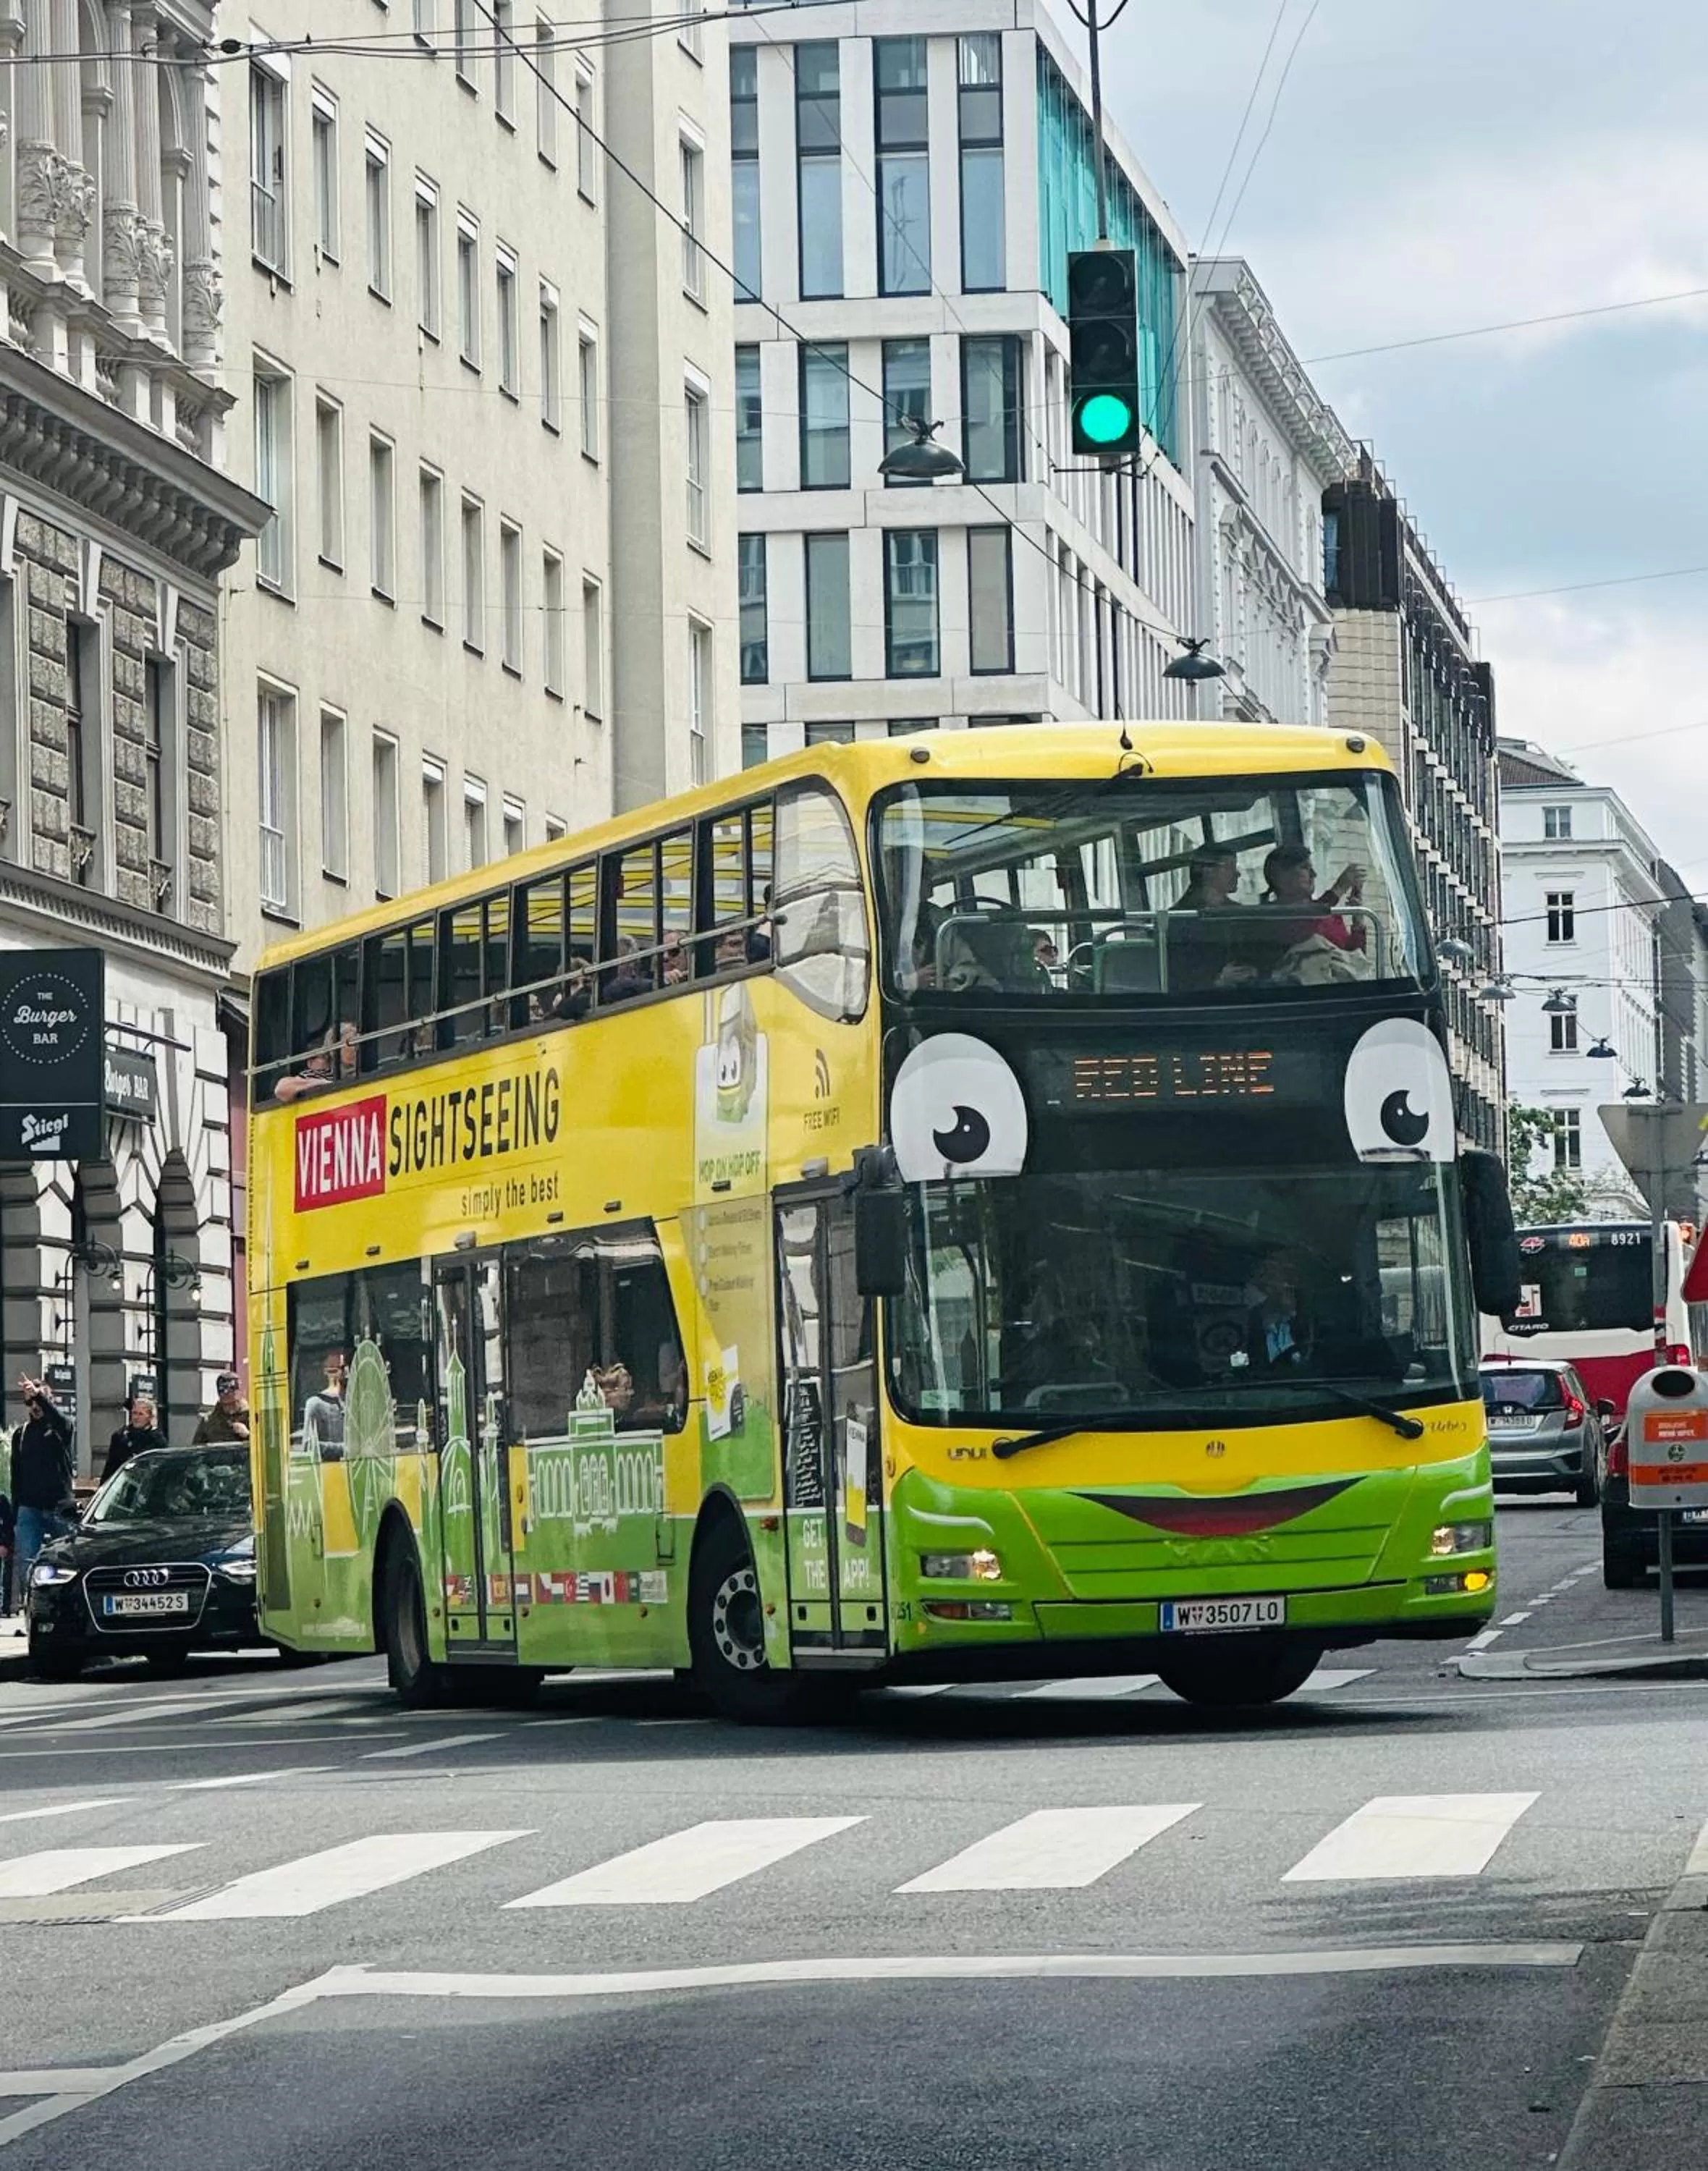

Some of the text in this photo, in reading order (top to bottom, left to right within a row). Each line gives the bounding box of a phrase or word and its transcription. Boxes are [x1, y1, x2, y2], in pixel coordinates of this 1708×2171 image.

[38, 992, 53, 1001] THE
[14, 1006, 77, 1028] Burger
[33, 1033, 58, 1044] BAR
[1173, 1051, 1274, 1096] LINE
[22, 1114, 68, 1144] Stiegl
[298, 1067, 559, 1198] VIENNA SIGHTSEEING
[802, 1111, 822, 1133] FREE
[462, 1172, 559, 1220] simply the best
[1611, 1232, 1641, 1245] 8921
[1508, 1323, 1550, 1332] CITARO
[803, 1519, 823, 1549] GET
[803, 1557, 870, 1589] THE APP!
